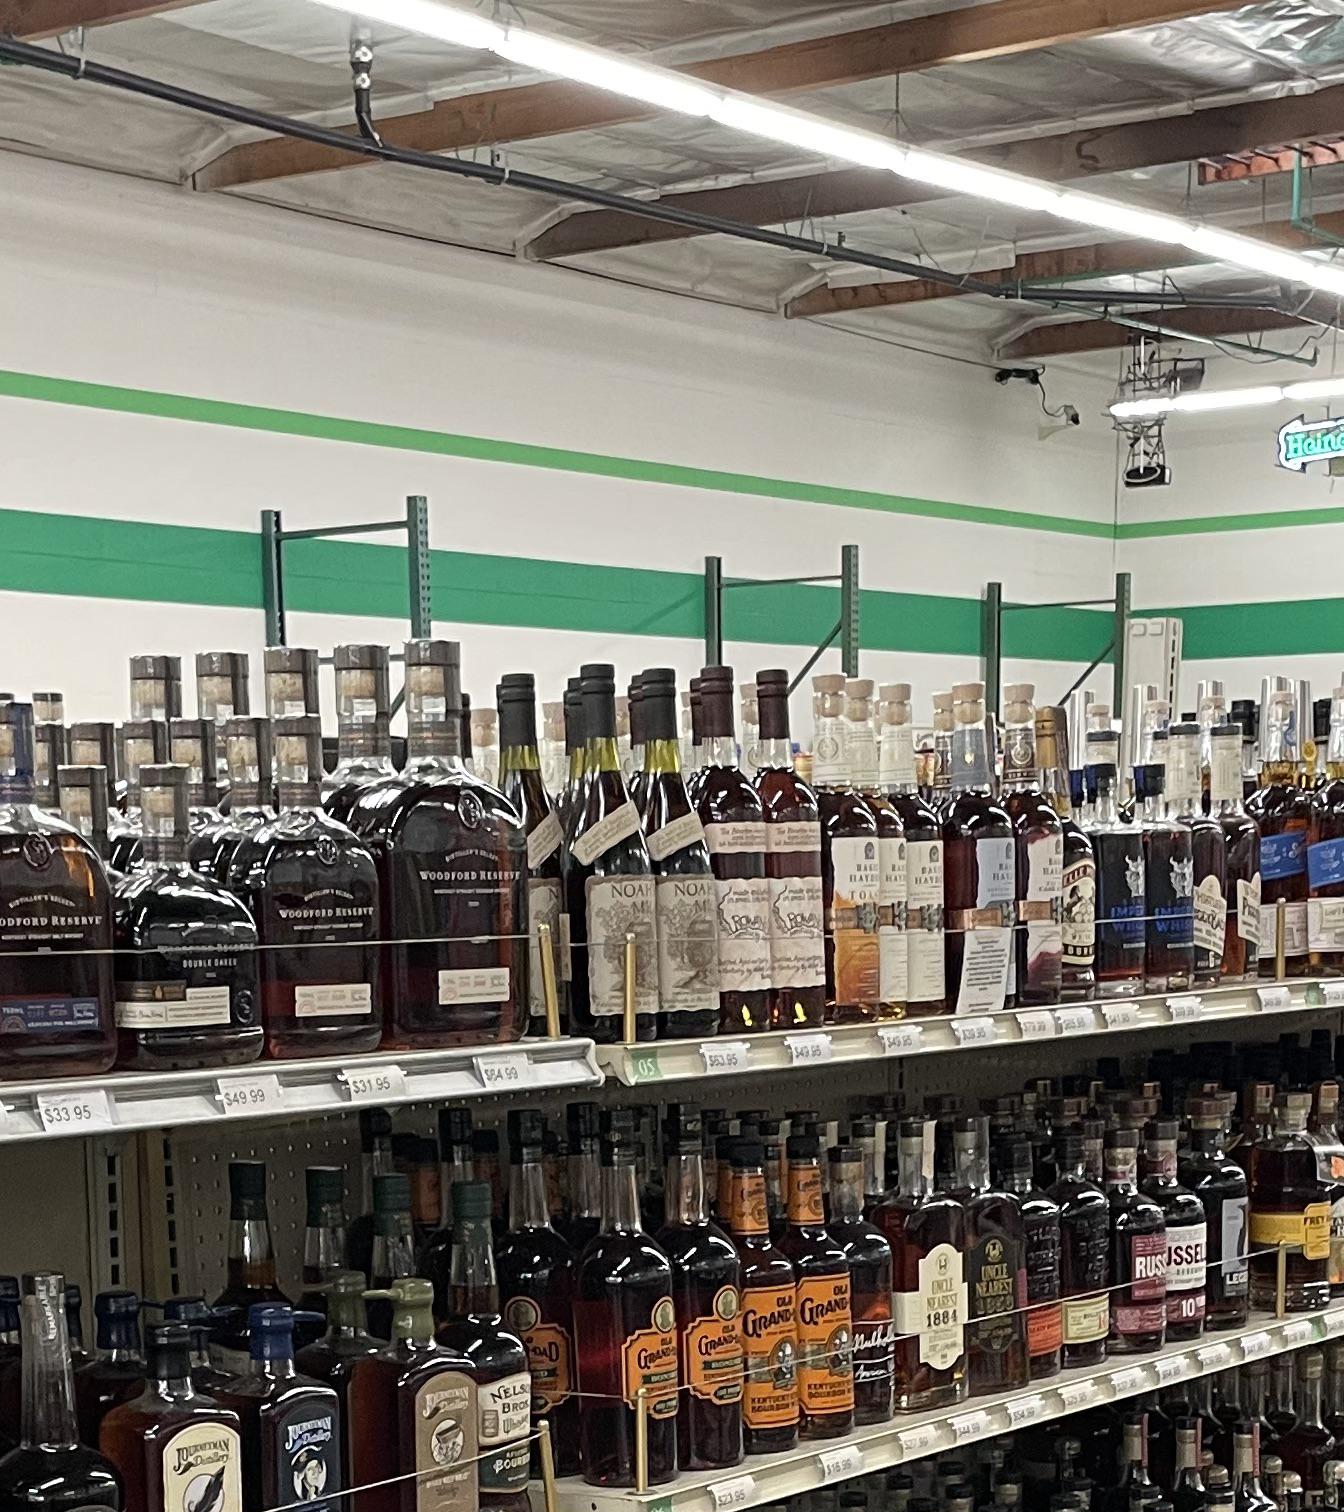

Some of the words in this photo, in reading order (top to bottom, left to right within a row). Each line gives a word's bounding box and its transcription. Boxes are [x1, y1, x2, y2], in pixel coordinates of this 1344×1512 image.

[419, 870, 479, 882] WOODFORD
[479, 869, 522, 881] RESERVE
[50, 914, 104, 927] RESERVE
[278, 908, 335, 920] WOODFORD
[334, 906, 375, 918] RESERVE
[636, 1058, 656, 1077] 05
[351, 1077, 392, 1095] $31.95
[223, 1088, 266, 1107] $49.99
[44, 1104, 92, 1124] $33.95
[980, 1263, 1009, 1280] UNCLE
[975, 1278, 1014, 1297] NEAREST
[1180, 1298, 1197, 1318] 10
[926, 1309, 958, 1328] 1884
